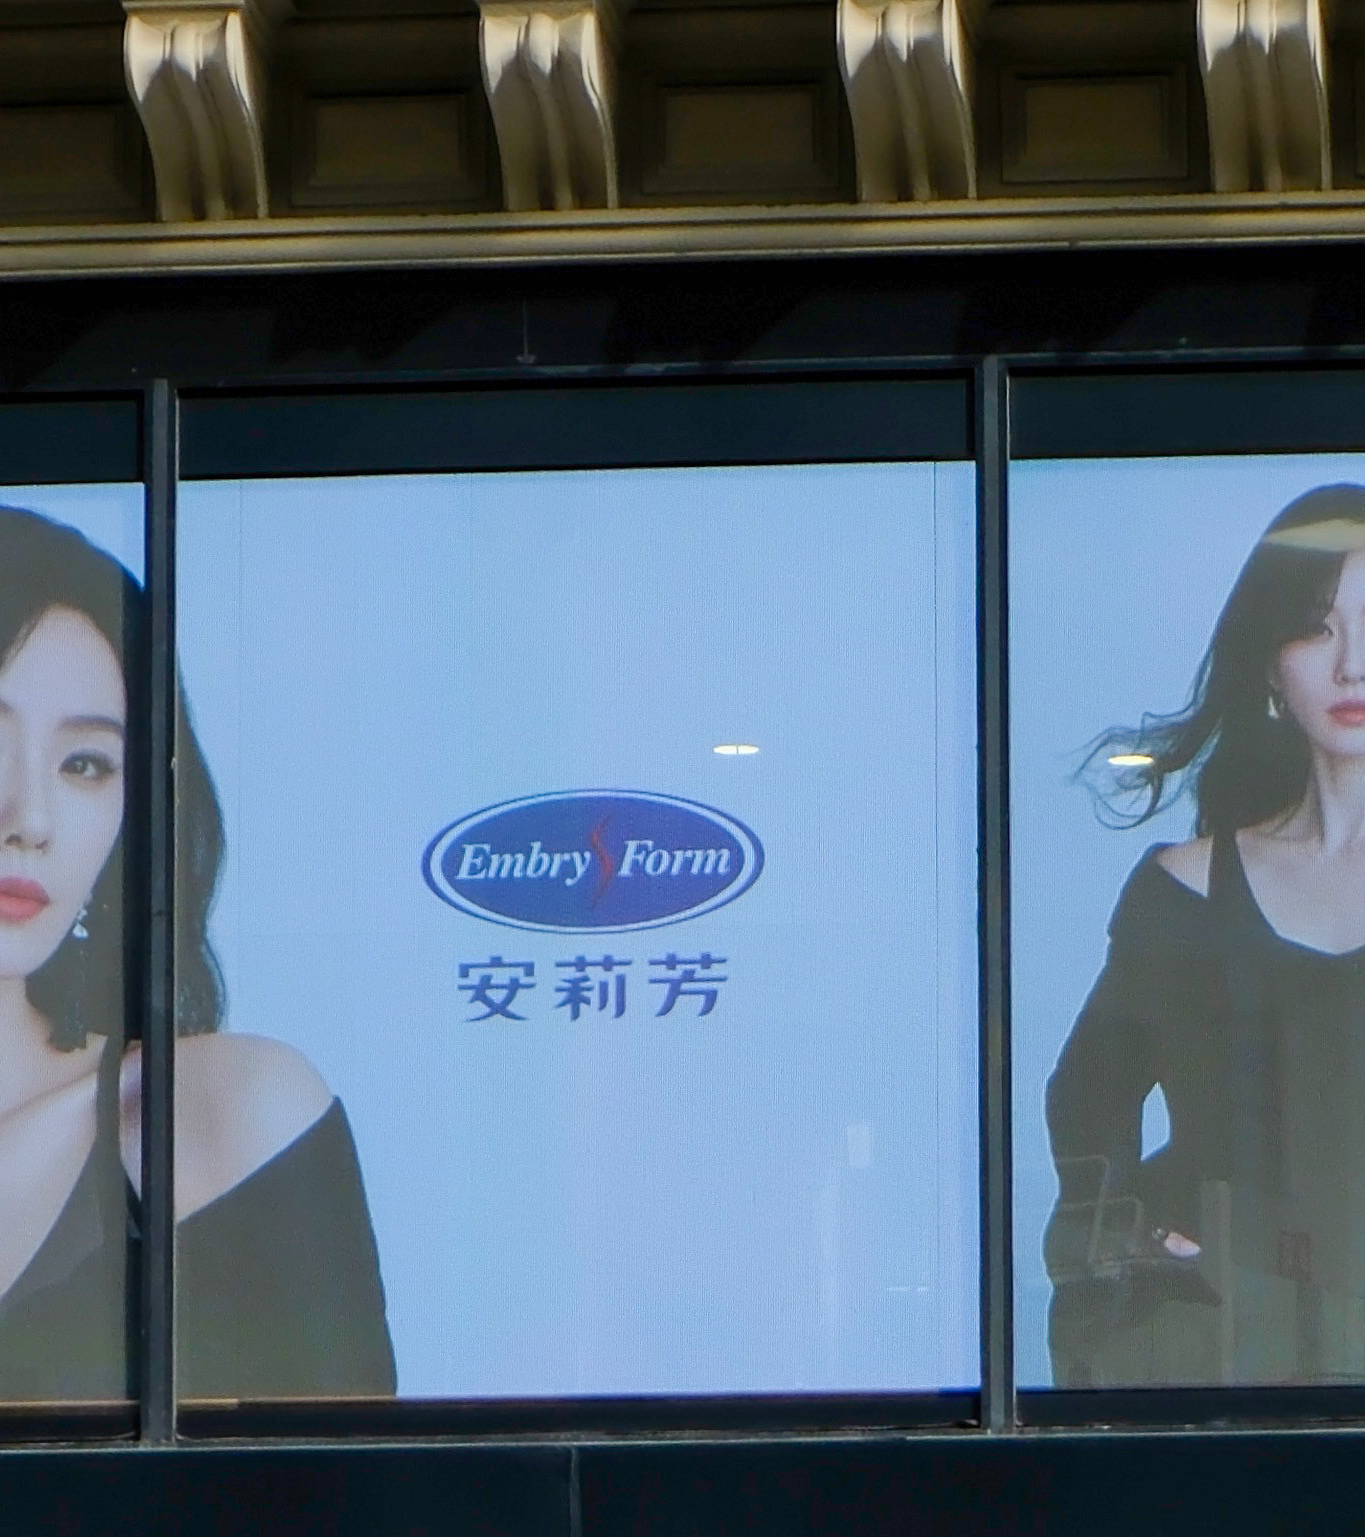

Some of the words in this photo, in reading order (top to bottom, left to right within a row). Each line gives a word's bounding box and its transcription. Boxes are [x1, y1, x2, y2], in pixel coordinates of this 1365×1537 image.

[455, 841, 591, 886] Embry
[617, 839, 731, 878] Form
[456, 951, 729, 1023] 安莉芳
